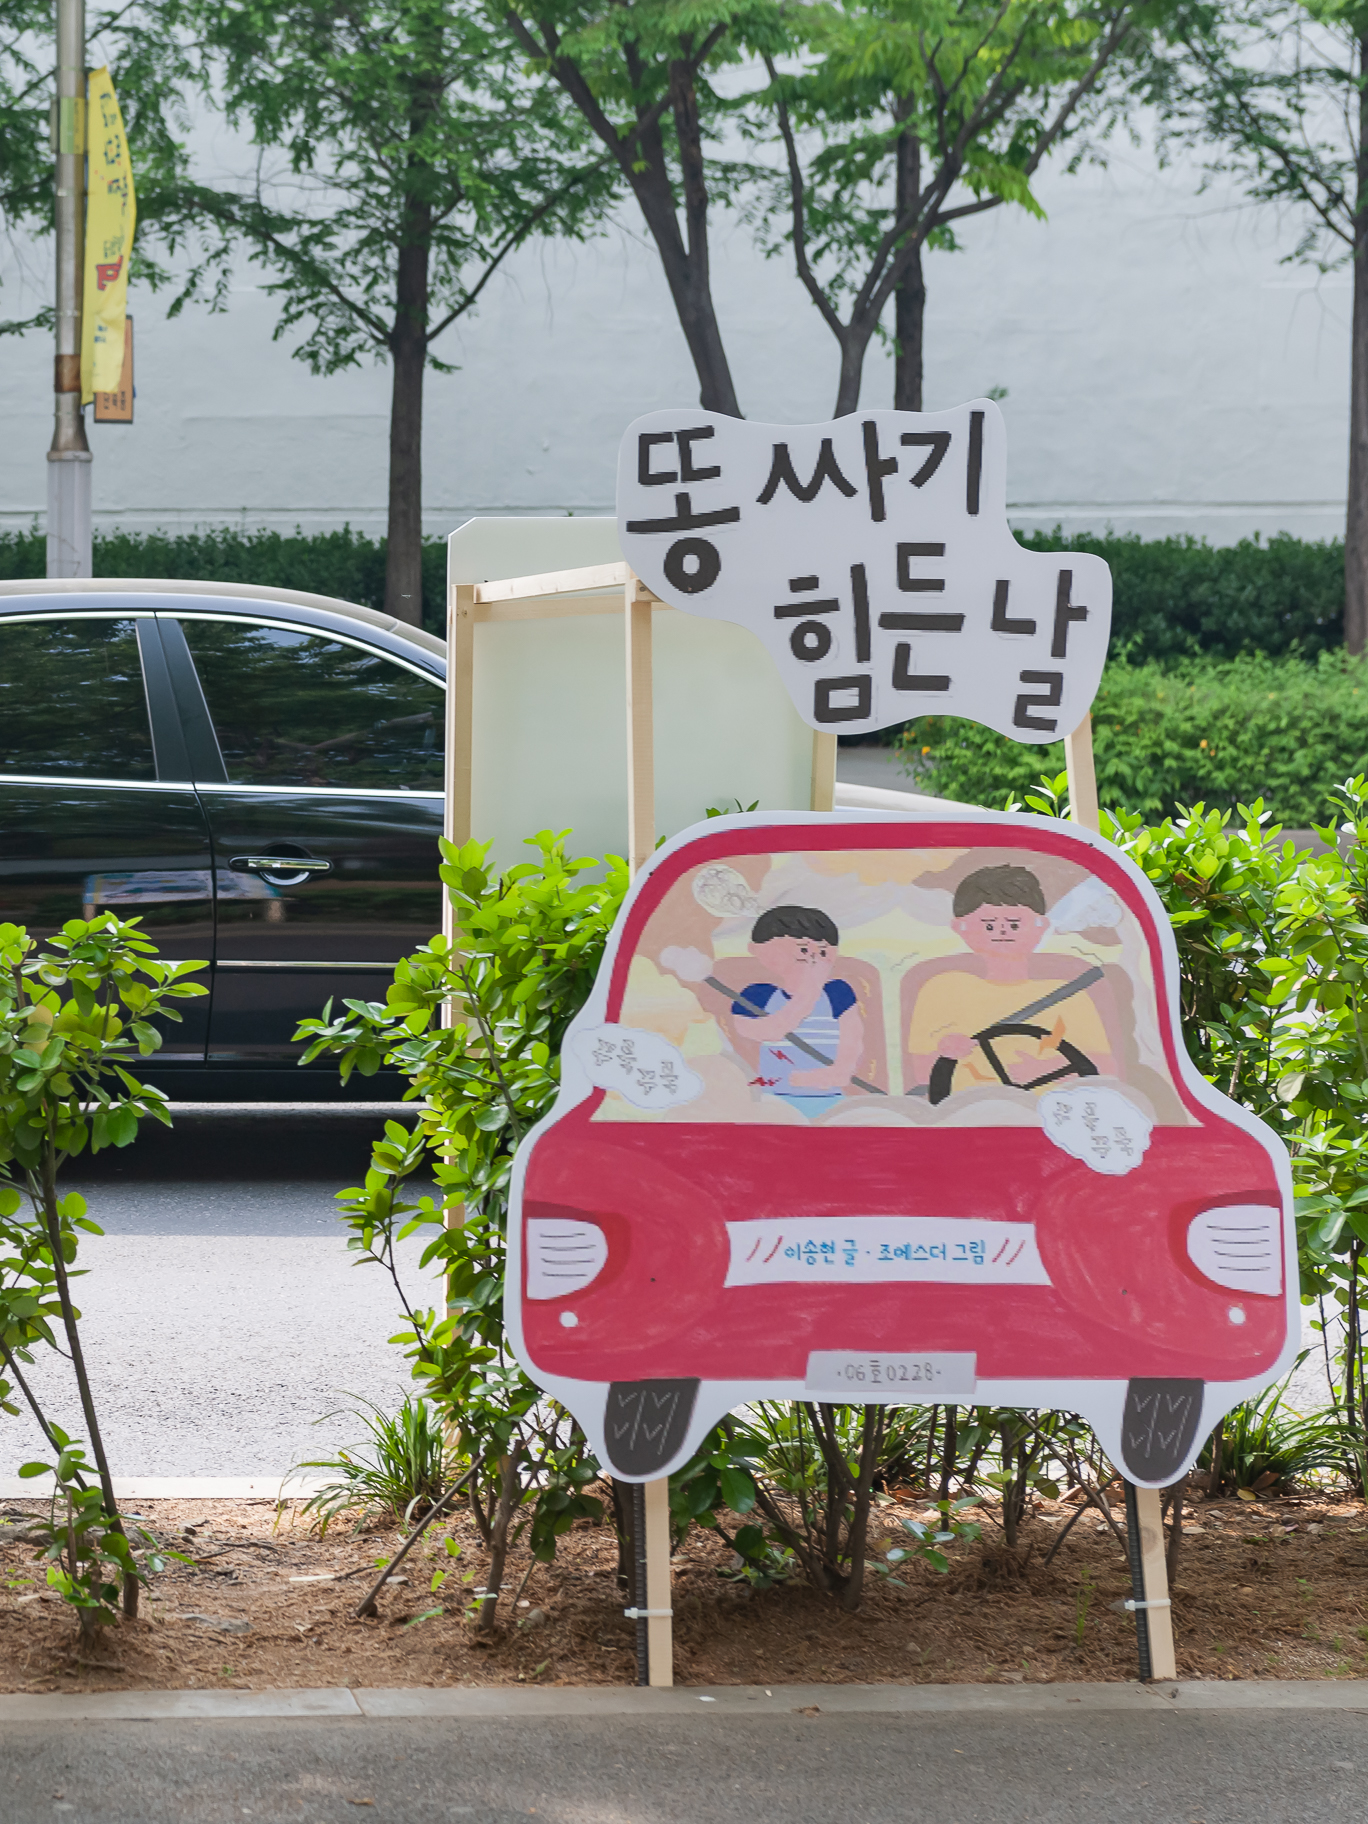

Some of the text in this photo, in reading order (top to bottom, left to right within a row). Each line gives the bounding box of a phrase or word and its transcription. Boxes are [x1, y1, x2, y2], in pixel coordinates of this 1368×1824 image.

[626, 410, 988, 594] 똥 싸기
[774, 542, 1089, 733] 힘든 날
[784, 1239, 987, 1267] 이송현 글 조에스더 그림
